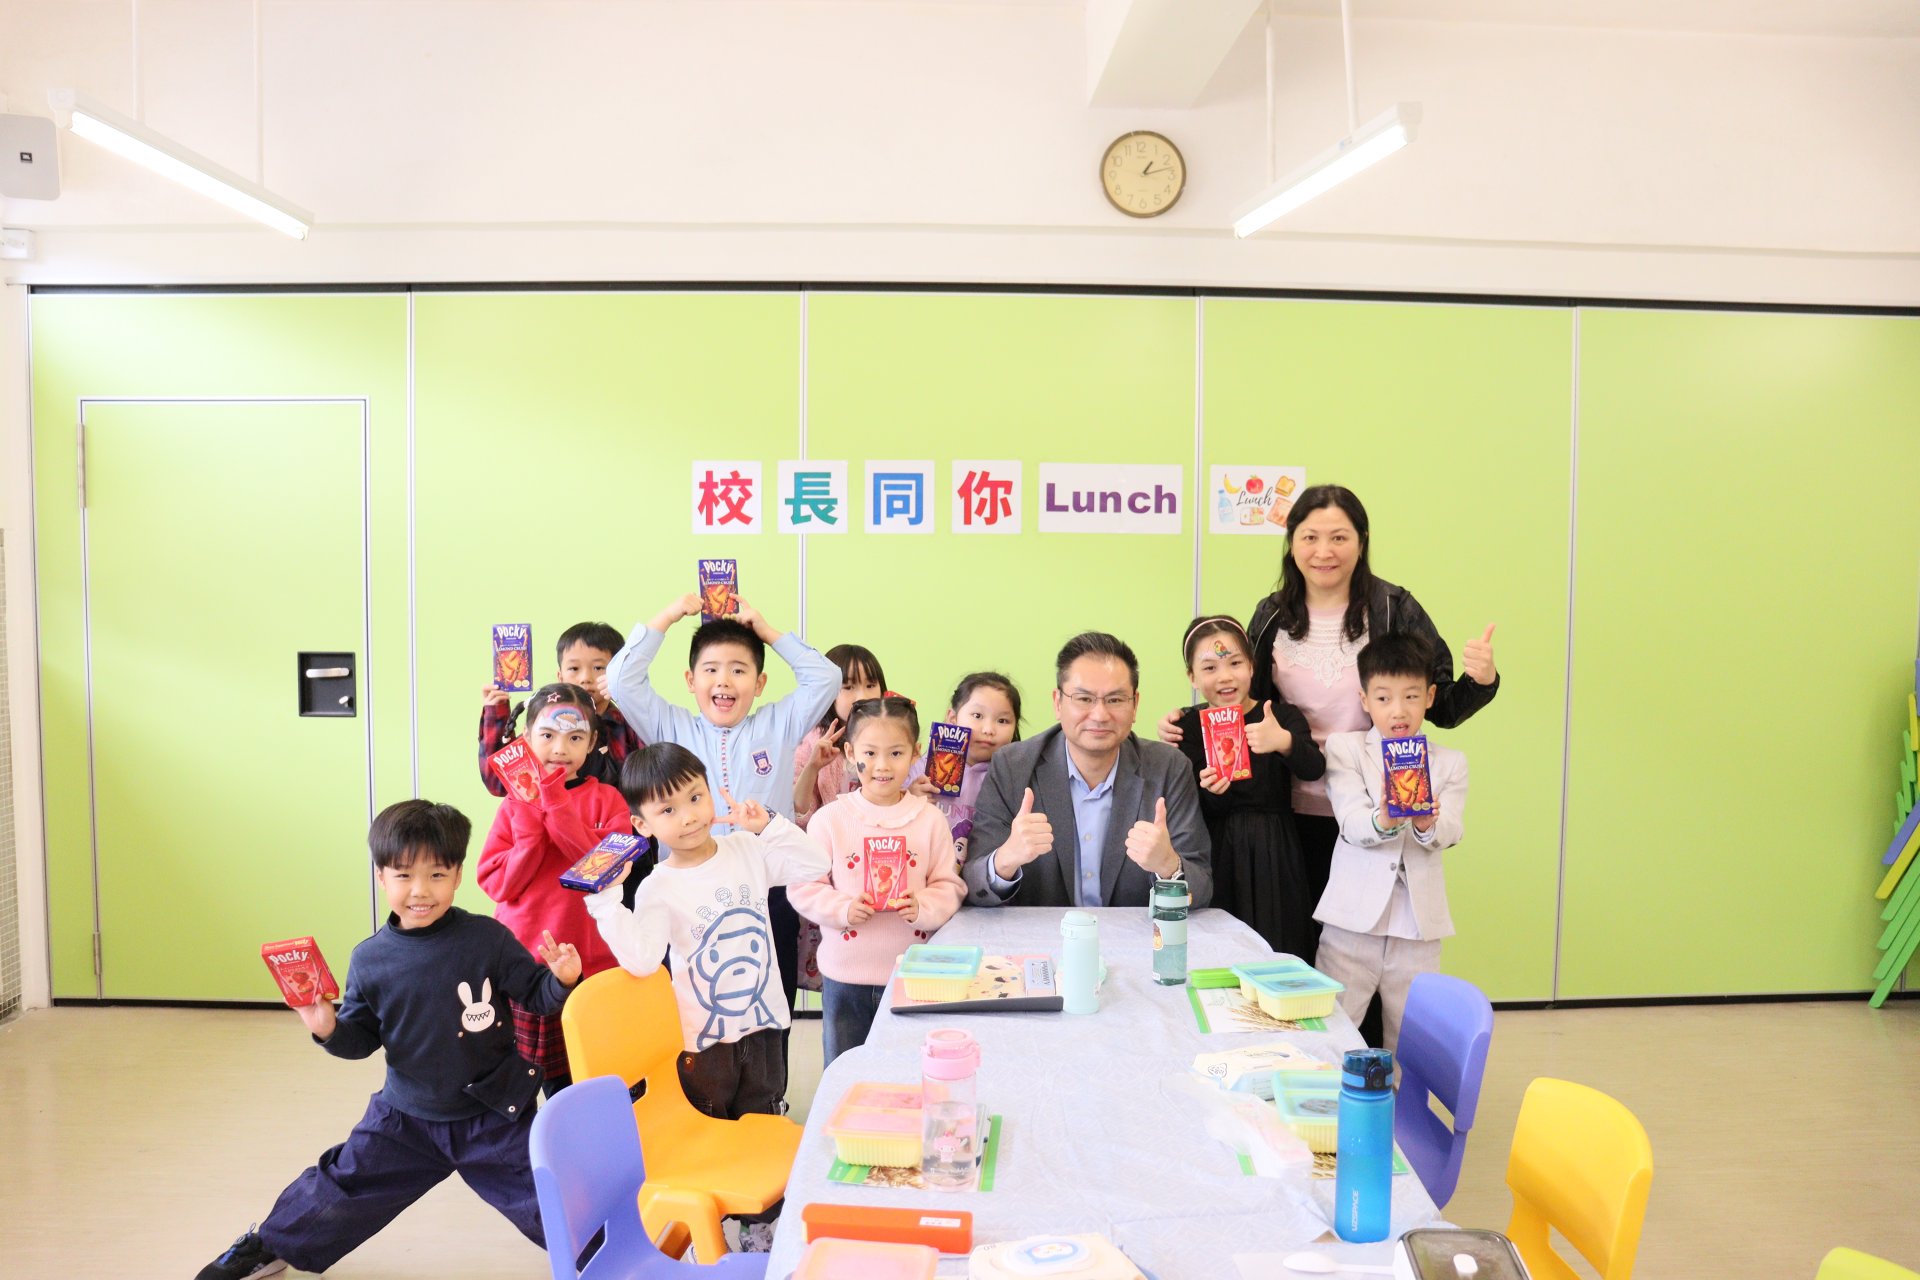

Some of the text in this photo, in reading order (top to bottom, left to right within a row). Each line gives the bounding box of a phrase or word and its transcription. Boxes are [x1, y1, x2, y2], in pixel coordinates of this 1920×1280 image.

[1124, 145, 1132, 156] 11
[1136, 142, 1146, 153] 12
[1112, 156, 1123, 167] 10
[1163, 154, 1171, 165] 2
[1168, 170, 1176, 181] 3
[1114, 185, 1122, 196] 8
[1164, 184, 1171, 195] 4
[1127, 194, 1134, 206] 7
[1139, 198, 1147, 209] 6
[1153, 194, 1162, 206] 5
[697, 470, 1177, 526] 校長同你 Lunch
[1236, 487, 1274, 506] Lunch
